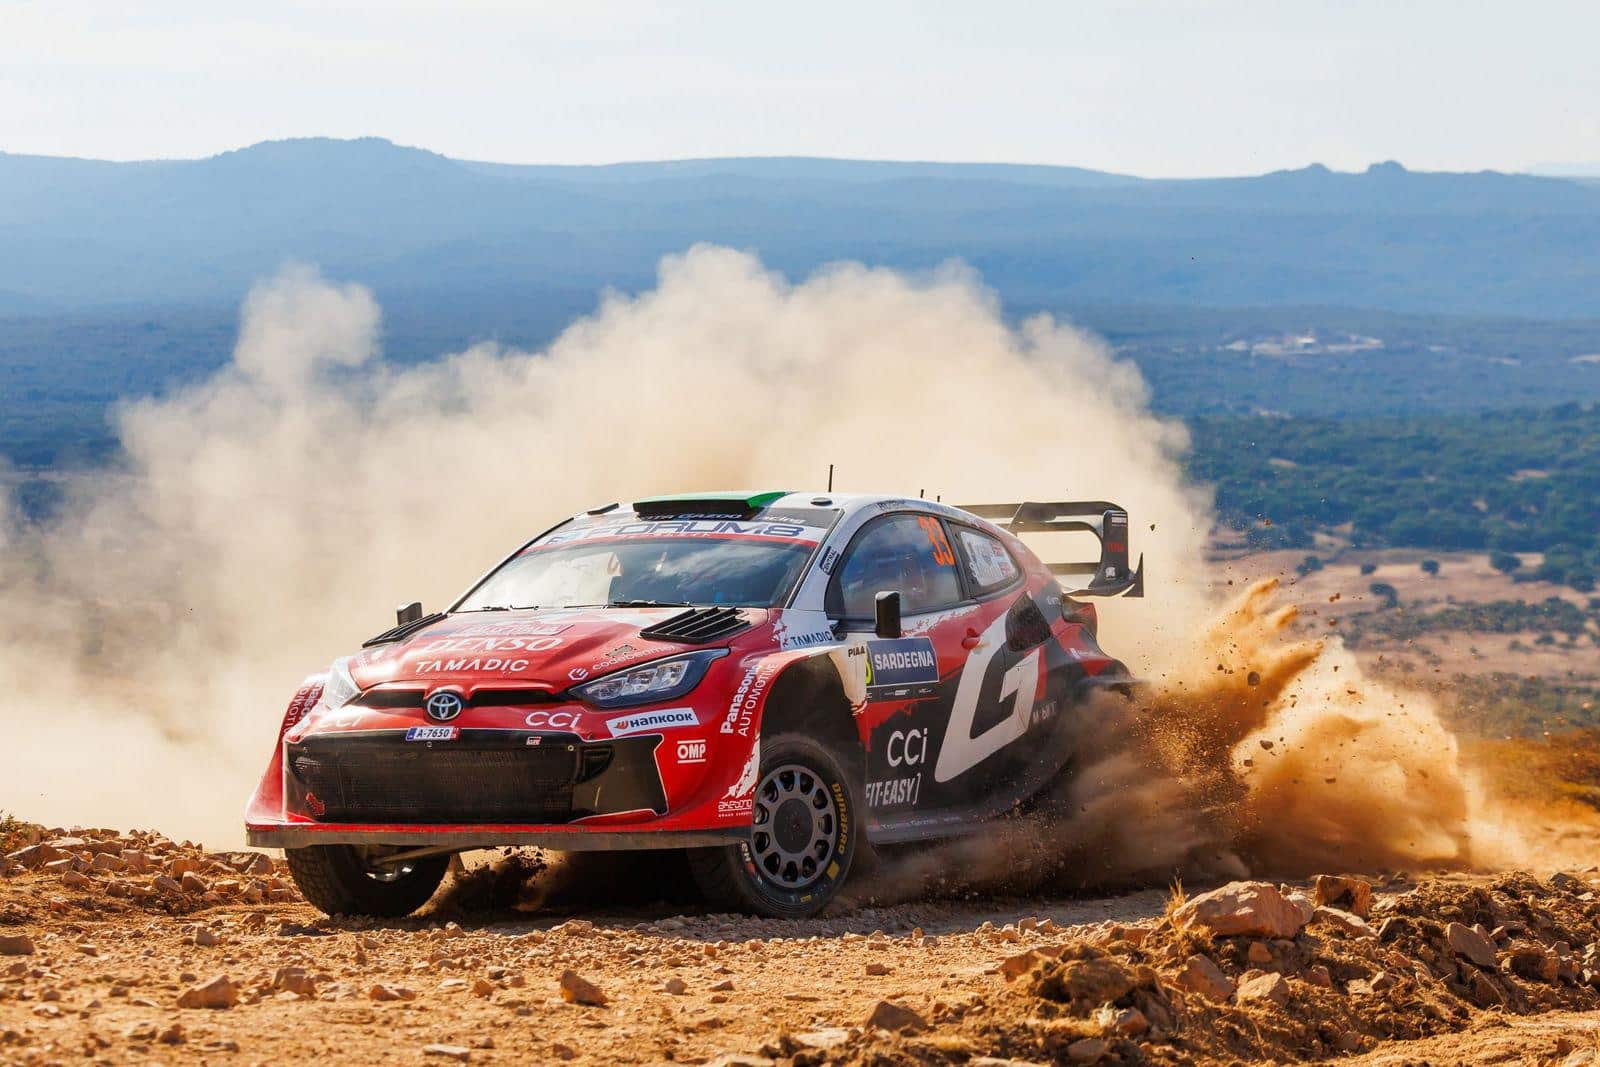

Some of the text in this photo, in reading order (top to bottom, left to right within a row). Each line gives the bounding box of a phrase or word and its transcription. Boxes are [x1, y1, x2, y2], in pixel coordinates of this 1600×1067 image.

[917, 516, 955, 566] 33
[423, 636, 563, 652] DENSO
[790, 631, 833, 648] TAMADIC
[848, 645, 866, 658] PIAA
[874, 651, 935, 670] SARDEGNA
[415, 658, 530, 674] TAMADIC
[719, 662, 760, 735] Panasonic
[736, 661, 780, 737] AUTOMOTIVE
[525, 711, 582, 729] CCi
[415, 727, 450, 739] A-7650
[676, 741, 706, 760] OMP
[887, 727, 928, 768] CCi
